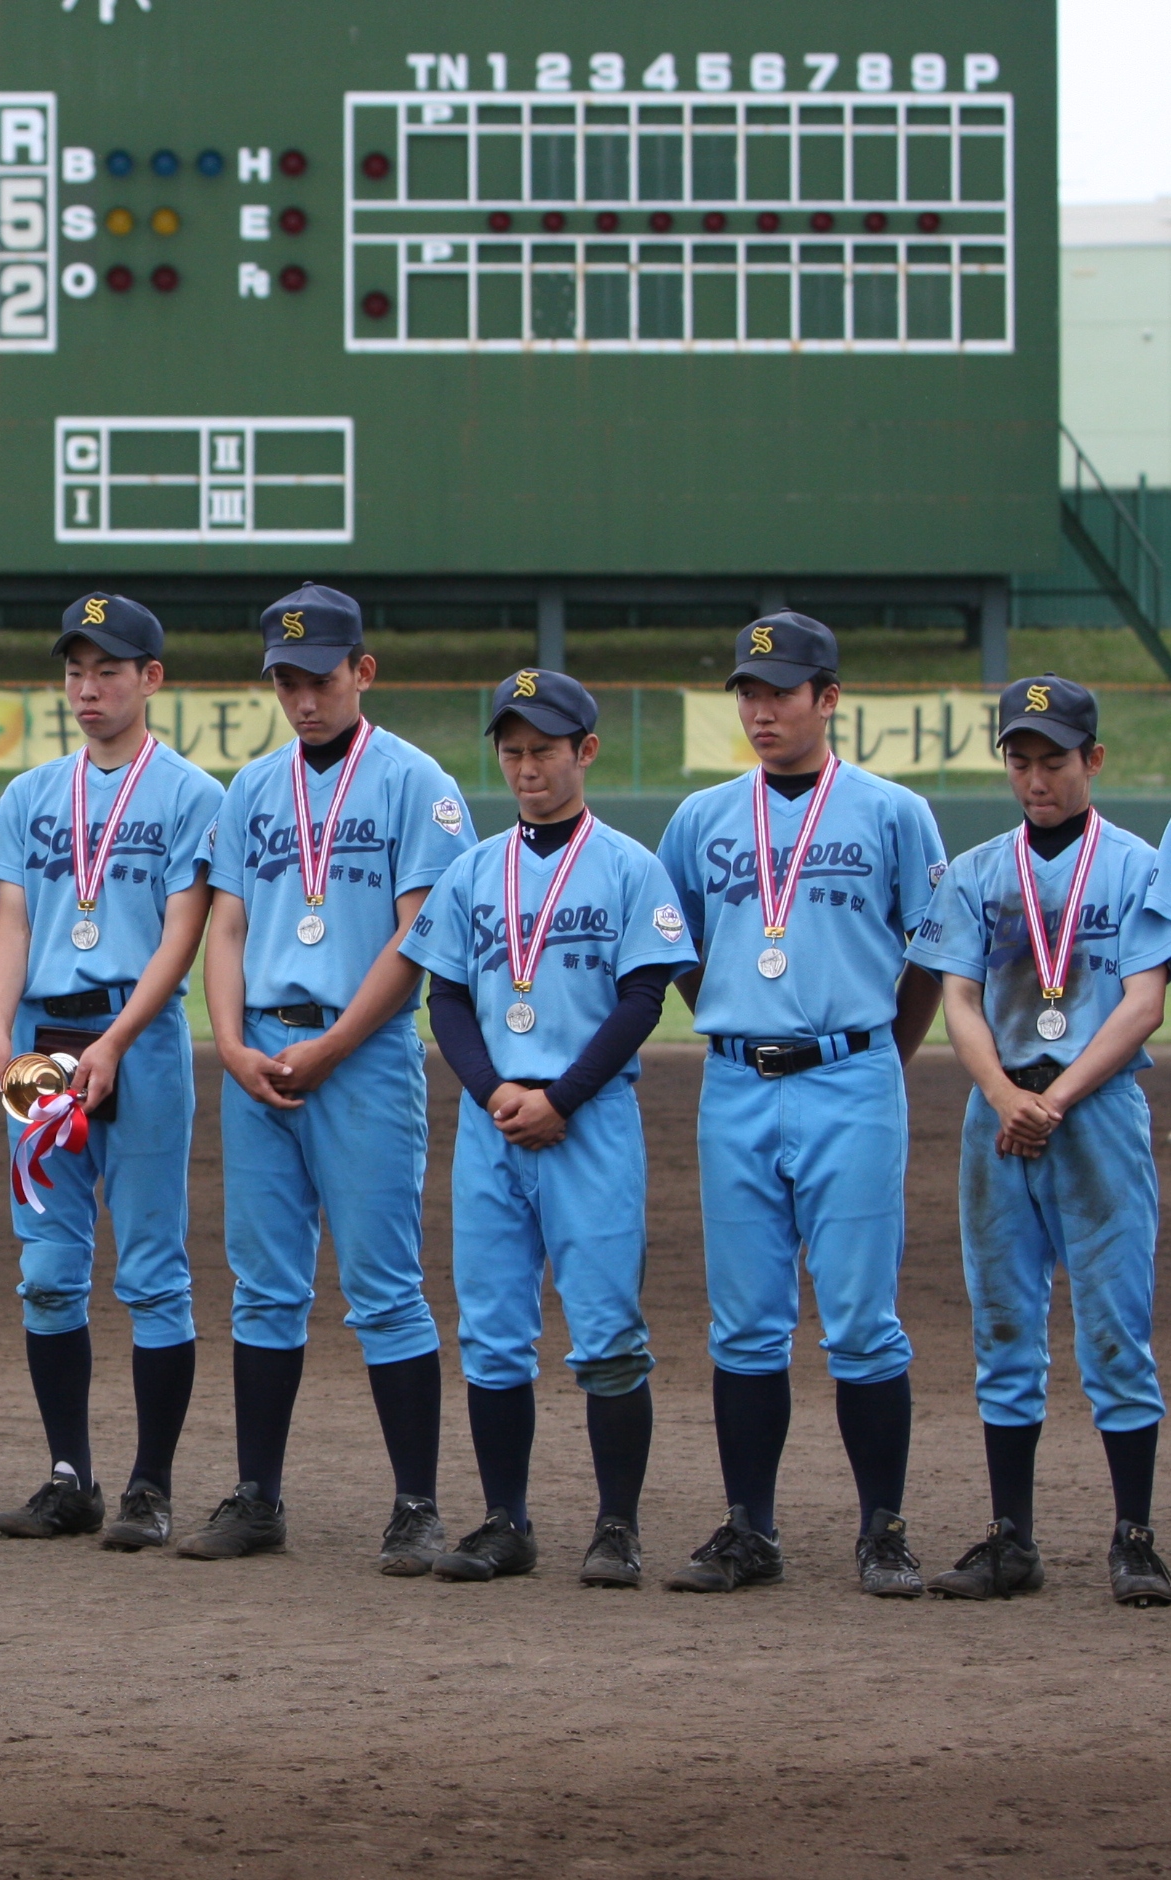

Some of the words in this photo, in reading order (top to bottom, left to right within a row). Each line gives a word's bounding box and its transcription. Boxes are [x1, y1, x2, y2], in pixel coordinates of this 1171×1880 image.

[487, 53, 507, 90] 1
[536, 53, 570, 90] 2
[589, 53, 624, 90] 3
[643, 53, 677, 90] 4
[696, 53, 731, 90] 5
[750, 53, 785, 90] 6
[803, 53, 838, 90] 7
[857, 53, 891, 90] 8
[910, 53, 946, 90] 9
[964, 53, 998, 90] P
[421, 104, 453, 124] P
[0, 109, 45, 165] R
[62, 147, 96, 182] B
[238, 147, 271, 182] H
[62, 205, 97, 240] S
[240, 205, 270, 239] E
[421, 241, 453, 262] P
[0, 266, 46, 337] 2
[65, 436, 98, 469] C
[81, 598, 108, 625] S
[282, 611, 305, 640] S
[750, 626, 773, 655] S
[513, 671, 539, 698] S
[1024, 684, 1051, 712] S
[44, 697, 277, 760] キトレモン
[828, 703, 1002, 764] キレートレモ
